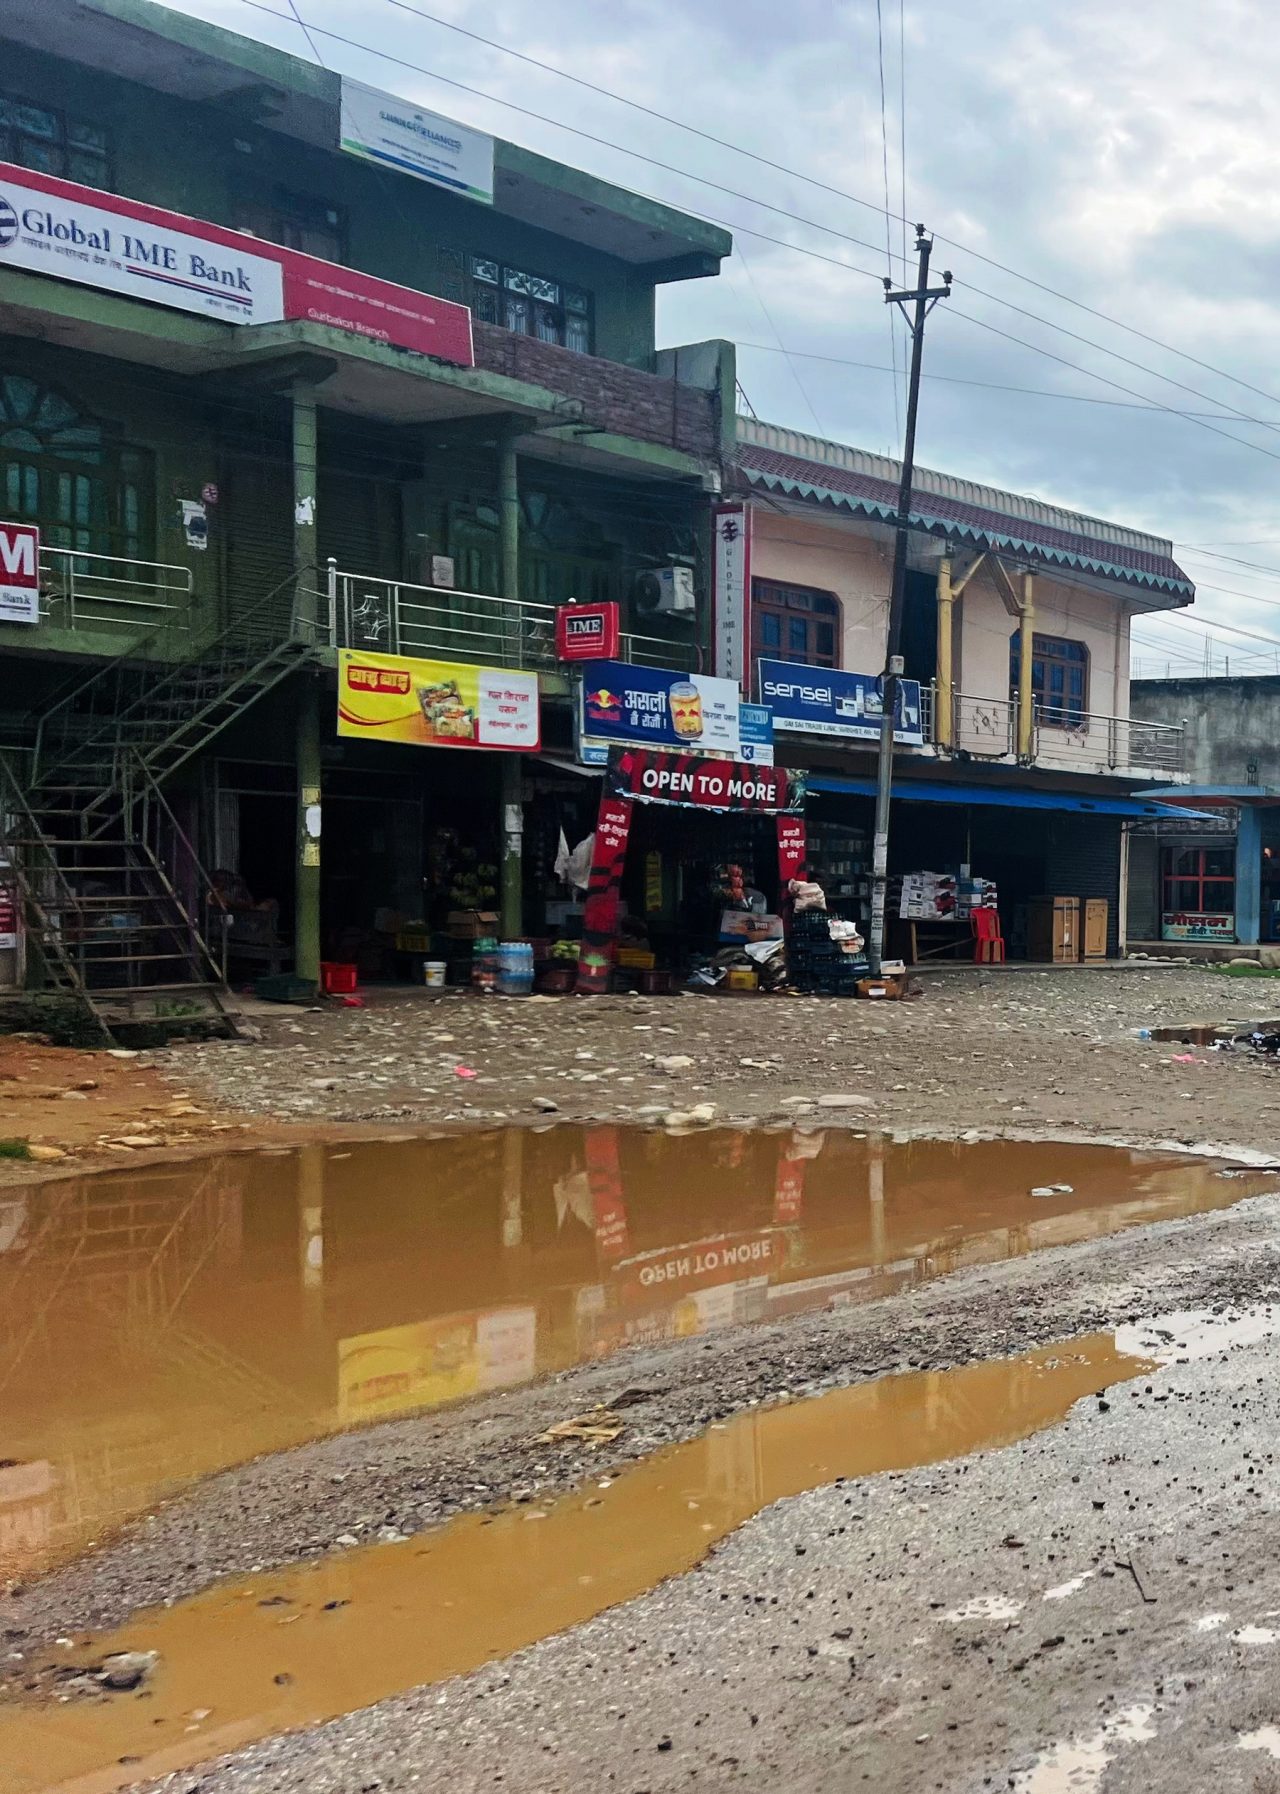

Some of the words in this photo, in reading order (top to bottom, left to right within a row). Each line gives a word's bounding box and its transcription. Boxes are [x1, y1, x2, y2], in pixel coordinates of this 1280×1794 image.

[22, 208, 110, 252] Global
[120, 234, 177, 270] IME
[189, 253, 253, 292] Bank
[572, 619, 601, 633] IME
[624, 690, 667, 713] असली
[764, 681, 832, 703] sensei
[642, 769, 694, 793] OPEN
[698, 776, 723, 795] TO
[727, 779, 776, 801] MORE
